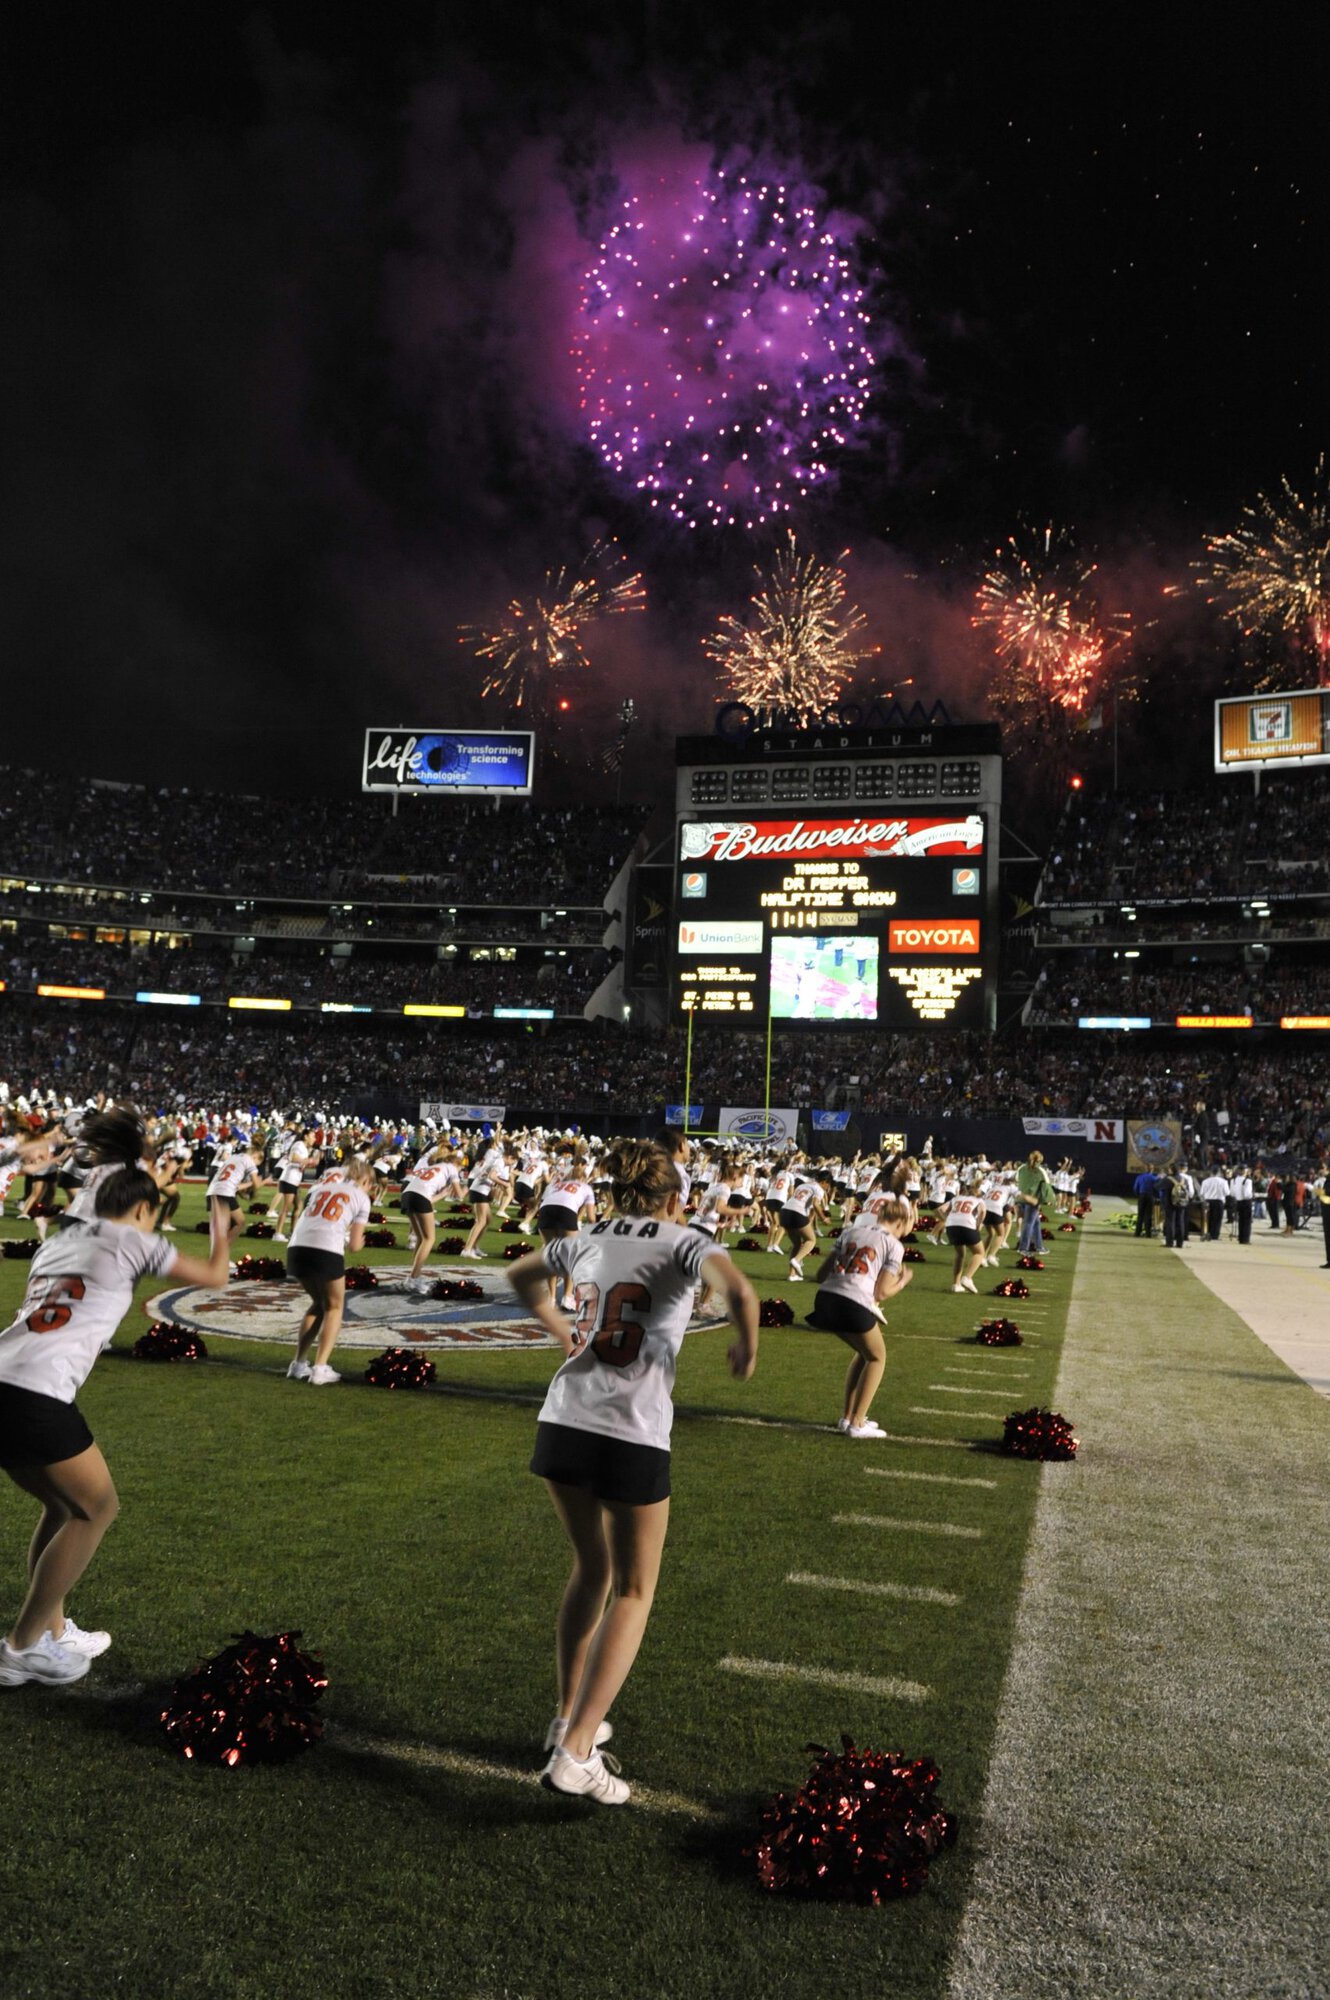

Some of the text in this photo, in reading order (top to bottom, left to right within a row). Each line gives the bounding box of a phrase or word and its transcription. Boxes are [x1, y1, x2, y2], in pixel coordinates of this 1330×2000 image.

[763, 734, 932, 750] STADIUM
[457, 744, 524, 757] Transforming
[368, 735, 423, 782] life
[471, 754, 508, 764] science
[708, 819, 908, 861] Budweiser
[794, 863, 860, 875] THANKS TO
[783, 876, 869, 891] DR PEPPER
[761, 891, 897, 906] HALFTIME SHOW
[771, 911, 817, 928] 11:14
[635, 925, 666, 939] Sprint
[700, 932, 761, 943] UnionBank
[893, 929, 975, 946] TOYOTA
[1179, 1017, 1251, 1027] WELLS FARGO
[1094, 1121, 1116, 1140] N
[884, 1134, 903, 1151] 25
[306, 1190, 350, 1222] 36
[954, 1200, 974, 1214] 36
